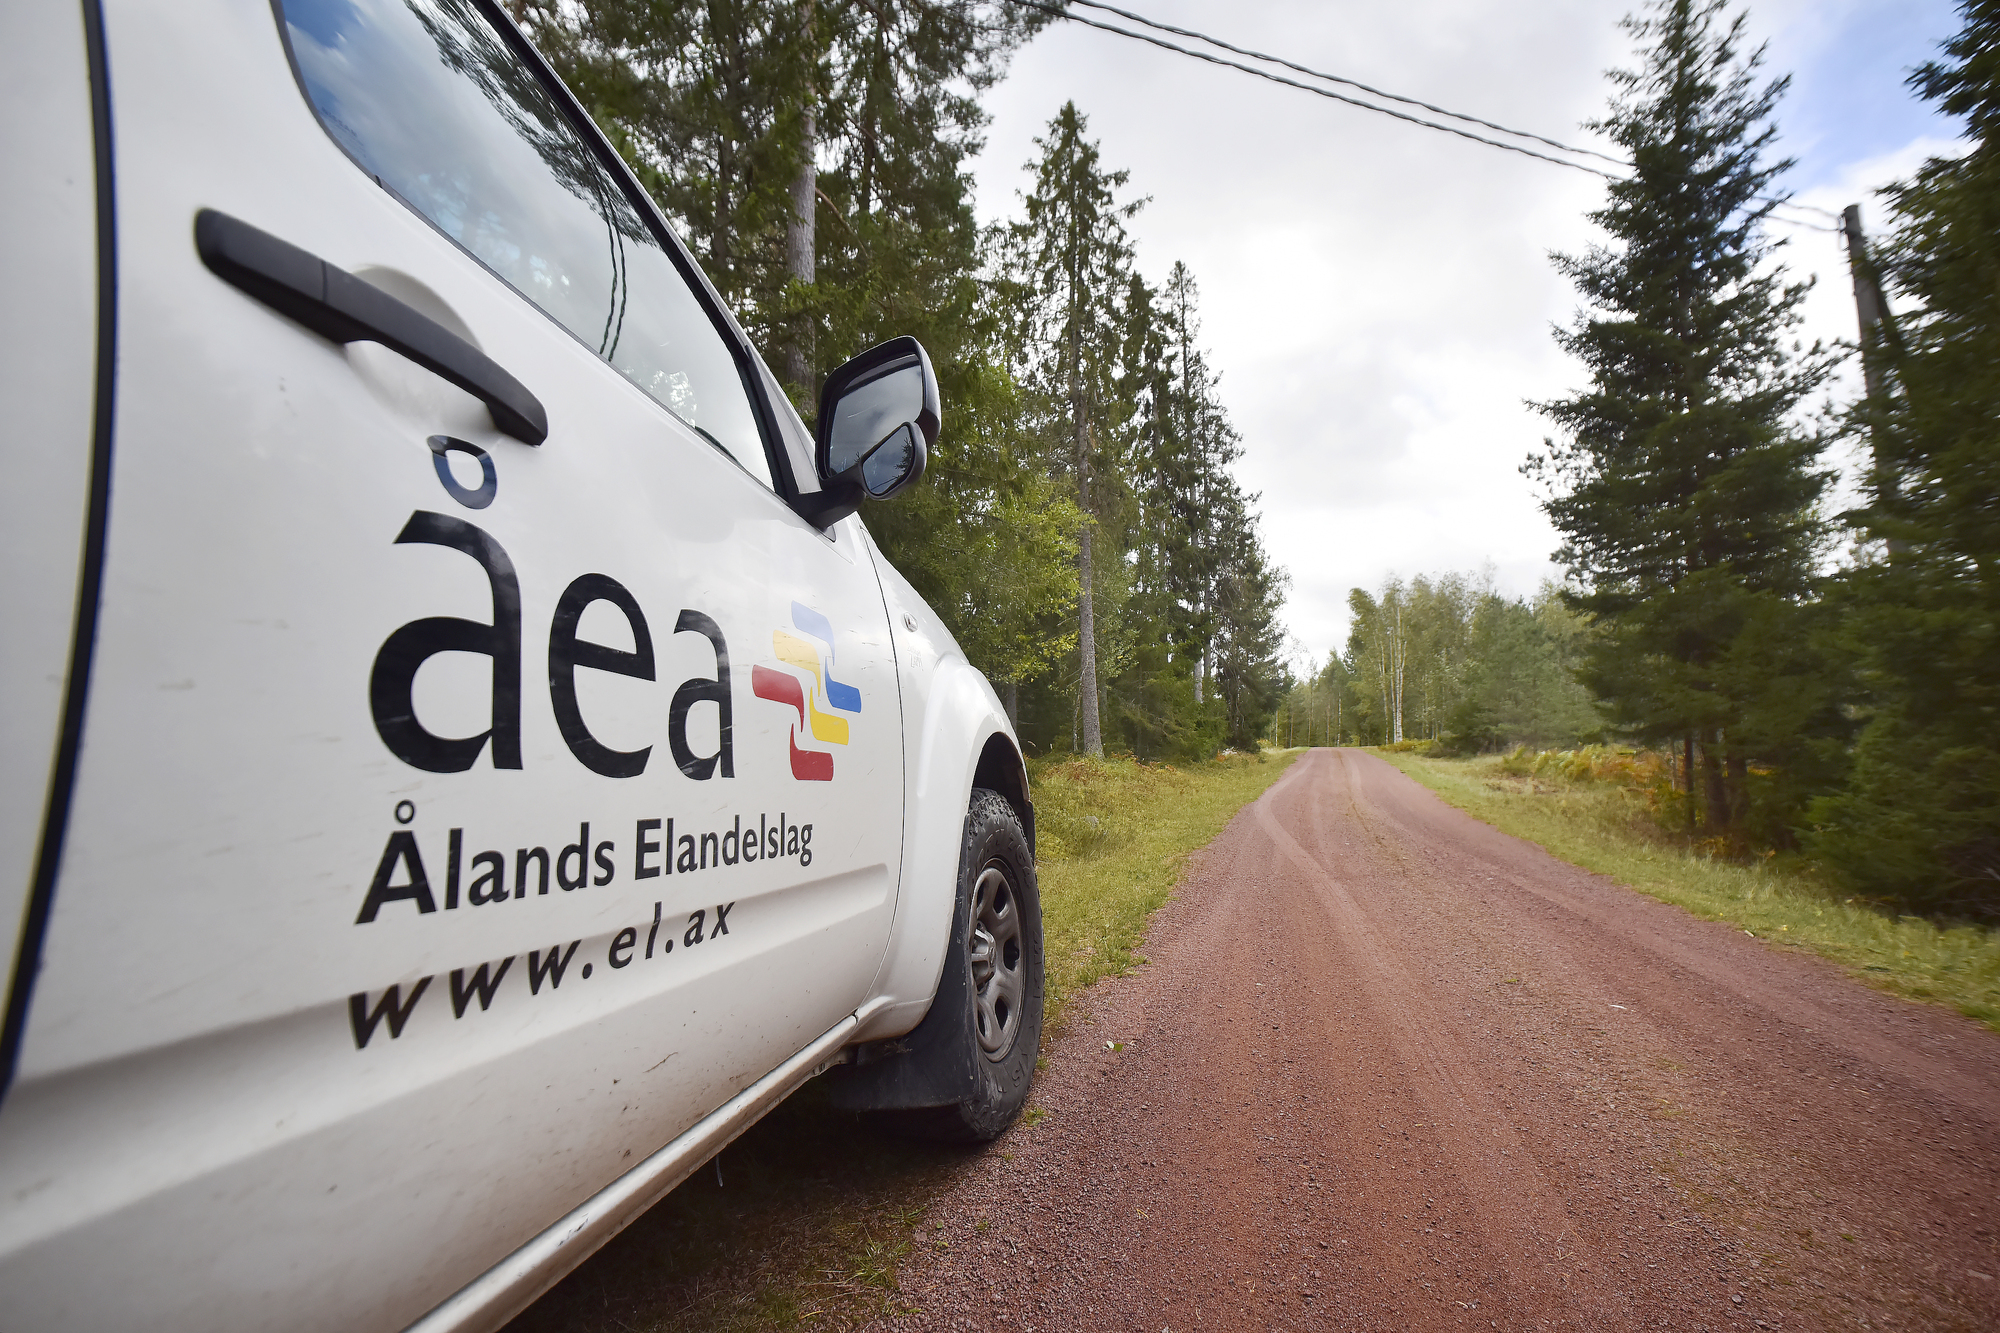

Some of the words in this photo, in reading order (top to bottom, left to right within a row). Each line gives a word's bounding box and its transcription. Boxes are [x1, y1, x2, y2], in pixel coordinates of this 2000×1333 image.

[369, 435, 735, 781] åea
[355, 799, 616, 925] Ålands
[634, 812, 813, 881] Elandelslag
[347, 901, 736, 1050] www.el.ax
